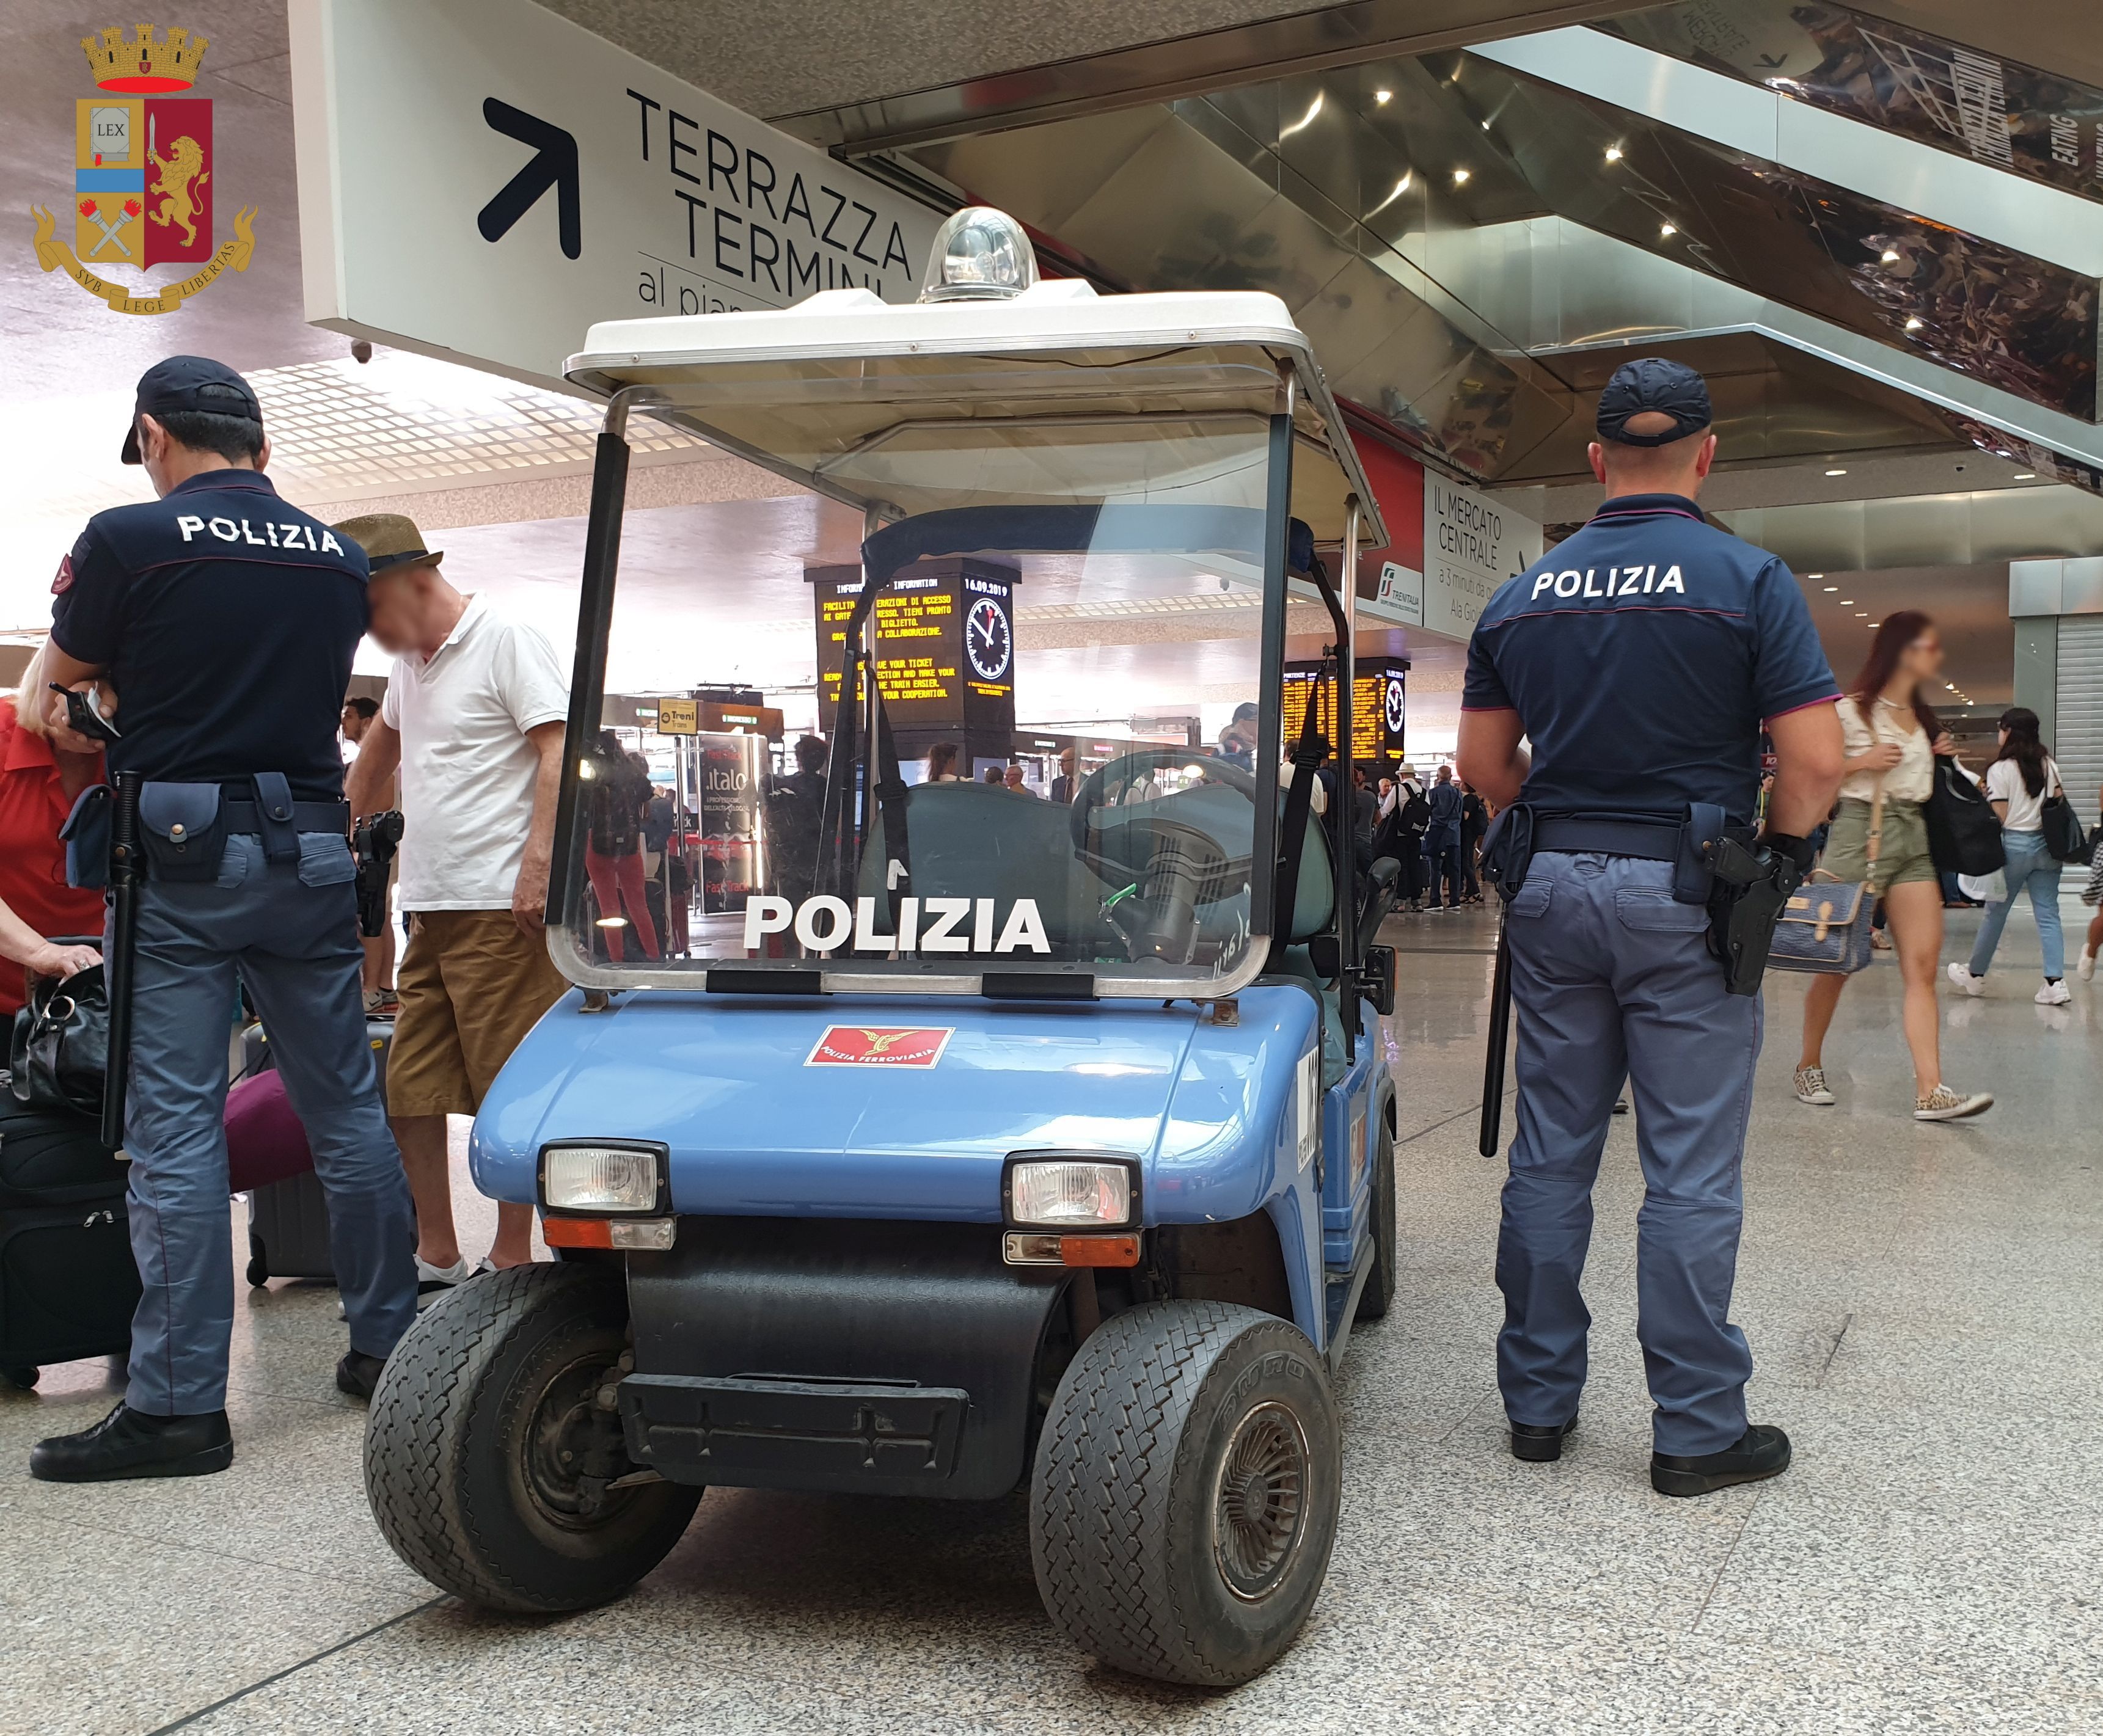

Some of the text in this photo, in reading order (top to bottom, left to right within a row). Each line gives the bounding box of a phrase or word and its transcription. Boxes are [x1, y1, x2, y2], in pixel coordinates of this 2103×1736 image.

[2049, 114, 2079, 167] EATING
[626, 88, 912, 282] TERRAZZA
[638, 266, 665, 308] al
[1434, 485, 1502, 541] IL MERCATO
[177, 515, 345, 557] POLIZIA
[1439, 522, 1498, 571] CENTRALE
[894, 579, 938, 590] INFORMATION
[965, 578, 1008, 597] 16.09.2019
[1439, 568, 1444, 583] a
[1446, 567, 1451, 587] 3
[1453, 572, 1474, 594] minuti
[1476, 578, 1485, 598] da
[1531, 565, 1685, 601] POLIZIA
[911, 596, 920, 606] DI
[923, 595, 951, 605] ACCESSO
[1392, 589, 1419, 607] TRENITALIA
[903, 607, 923, 617] TIENI
[926, 606, 952, 616] PRONTO
[1450, 598, 1463, 619] Ala
[881, 618, 919, 628] BIGLIETTO.
[885, 627, 942, 639] COLLABORAZIONE.
[890, 660, 905, 669] YOUR
[909, 658, 933, 668] TICKET
[904, 669, 916, 678] AND
[919, 668, 935, 677] MAKE
[938, 668, 956, 677] YOUR
[890, 680, 911, 690] TRAIN
[913, 679, 940, 688] EASIER.
[883, 690, 899, 700] YOUR
[902, 688, 948, 699] COOPERATION.
[671, 710, 695, 721] Treni
[706, 748, 722, 759] Fast
[725, 880, 750, 892] Track
[744, 895, 1052, 954] POLIZIA
[820, 1045, 935, 1063] POLIZIA FERROVIARIA
